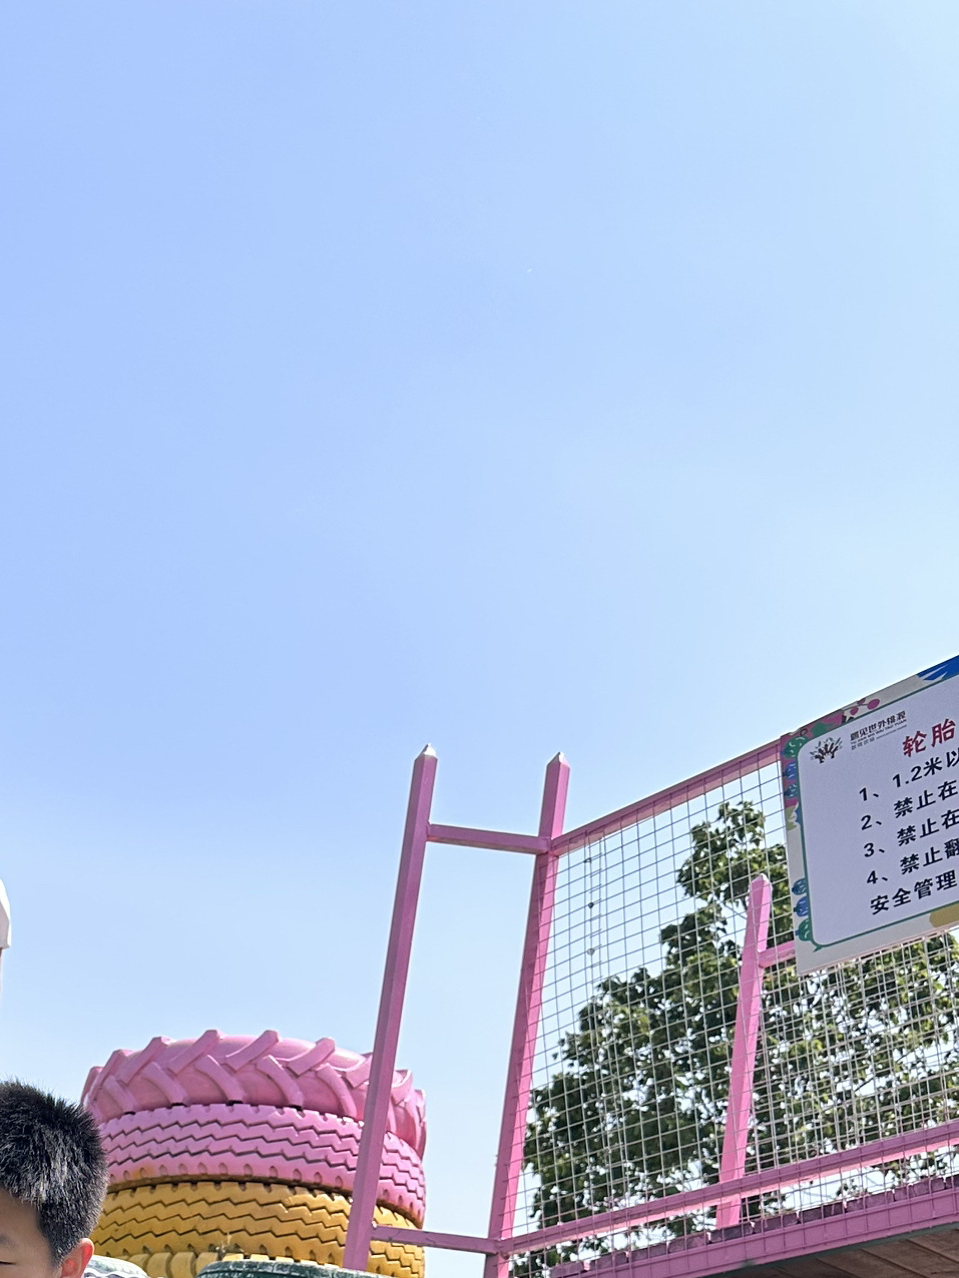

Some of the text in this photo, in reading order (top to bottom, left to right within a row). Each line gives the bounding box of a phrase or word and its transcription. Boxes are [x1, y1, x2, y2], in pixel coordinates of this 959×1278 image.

[902, 718, 956, 758] 轮胎
[869, 869, 958, 915] 安全管理
